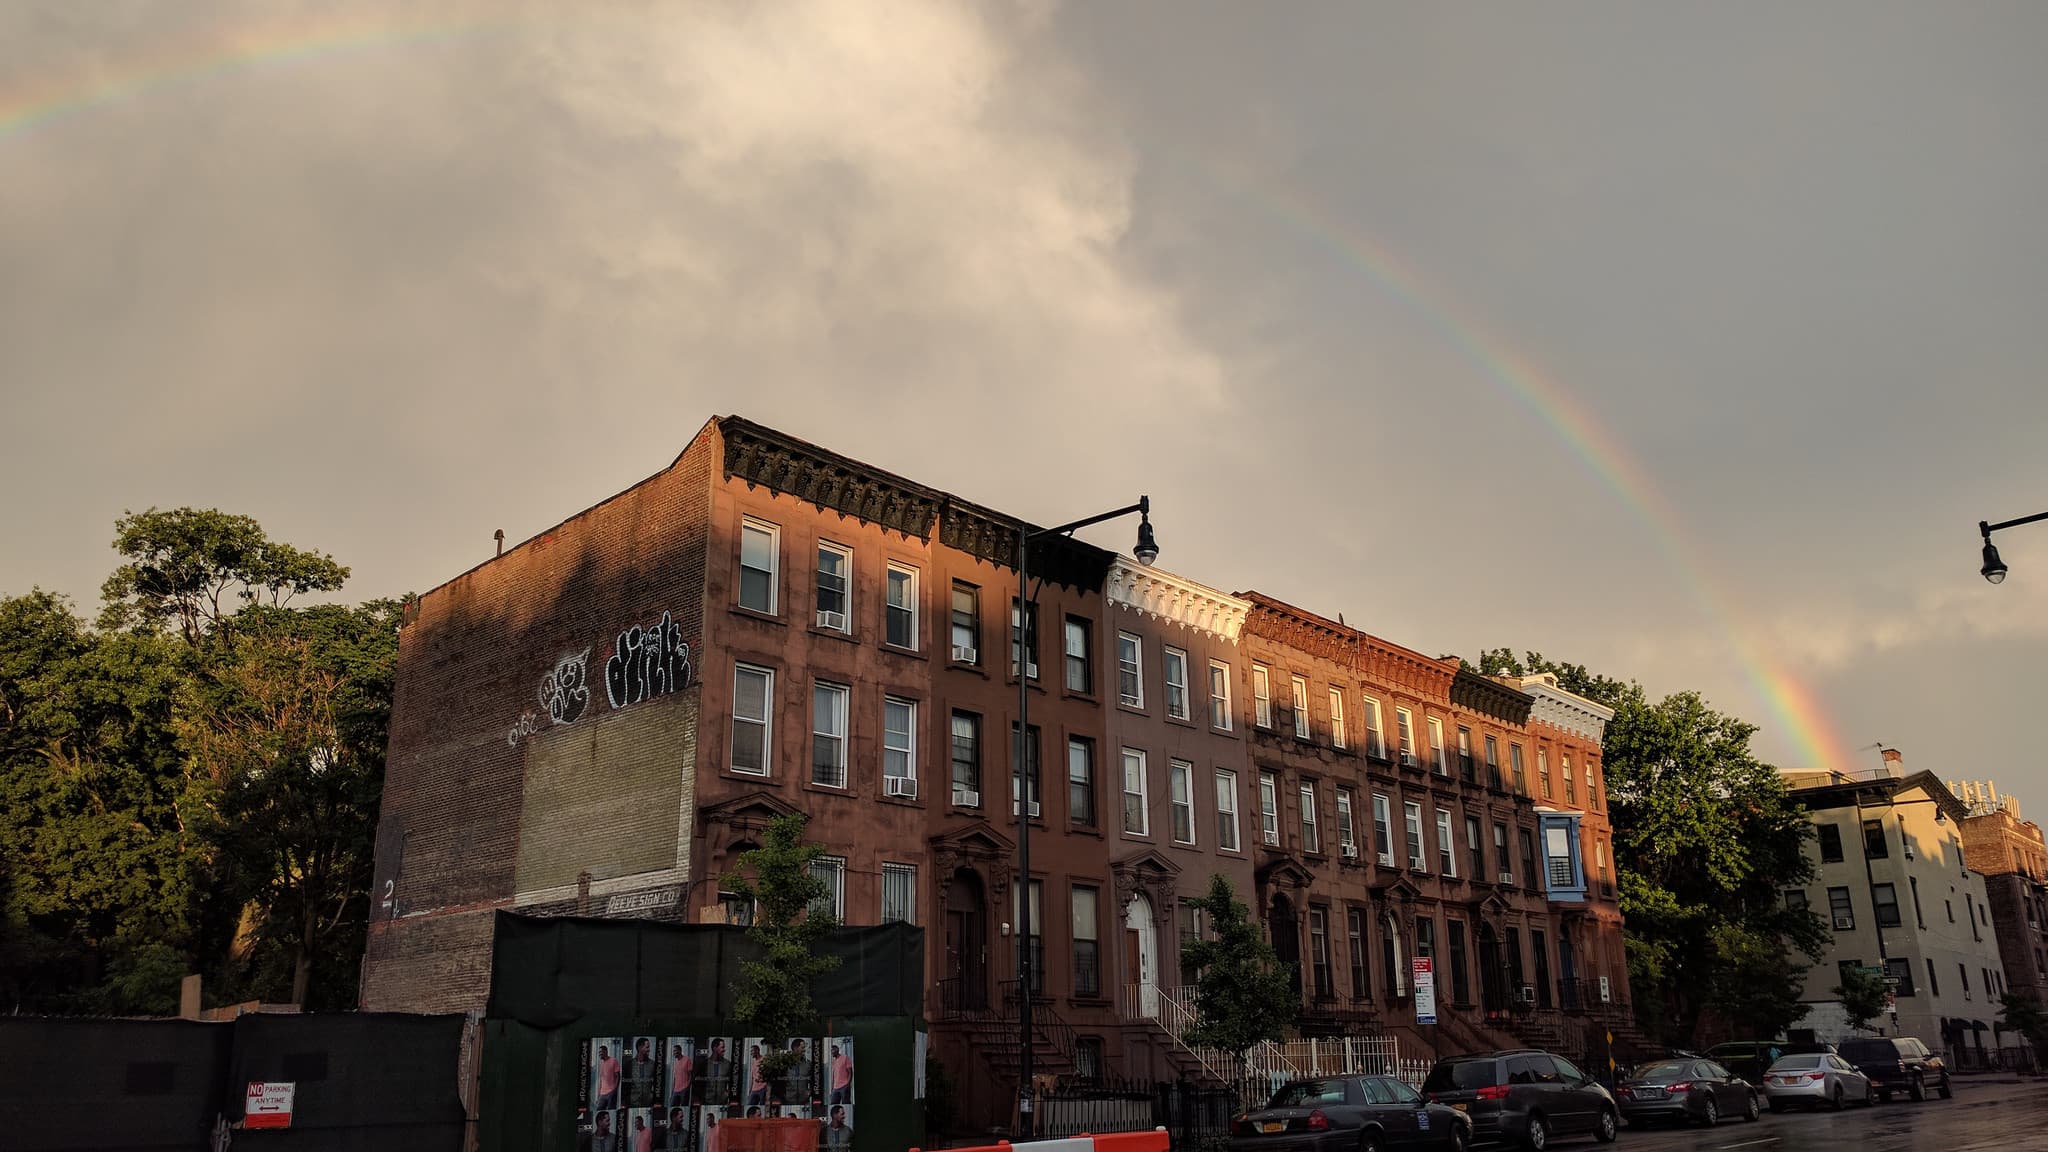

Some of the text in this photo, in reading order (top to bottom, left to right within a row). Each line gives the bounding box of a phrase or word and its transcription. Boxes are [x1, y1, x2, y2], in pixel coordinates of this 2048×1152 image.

[639, 892, 660, 907] SIGN
[250, 1085, 291, 1095] NO PARKING
